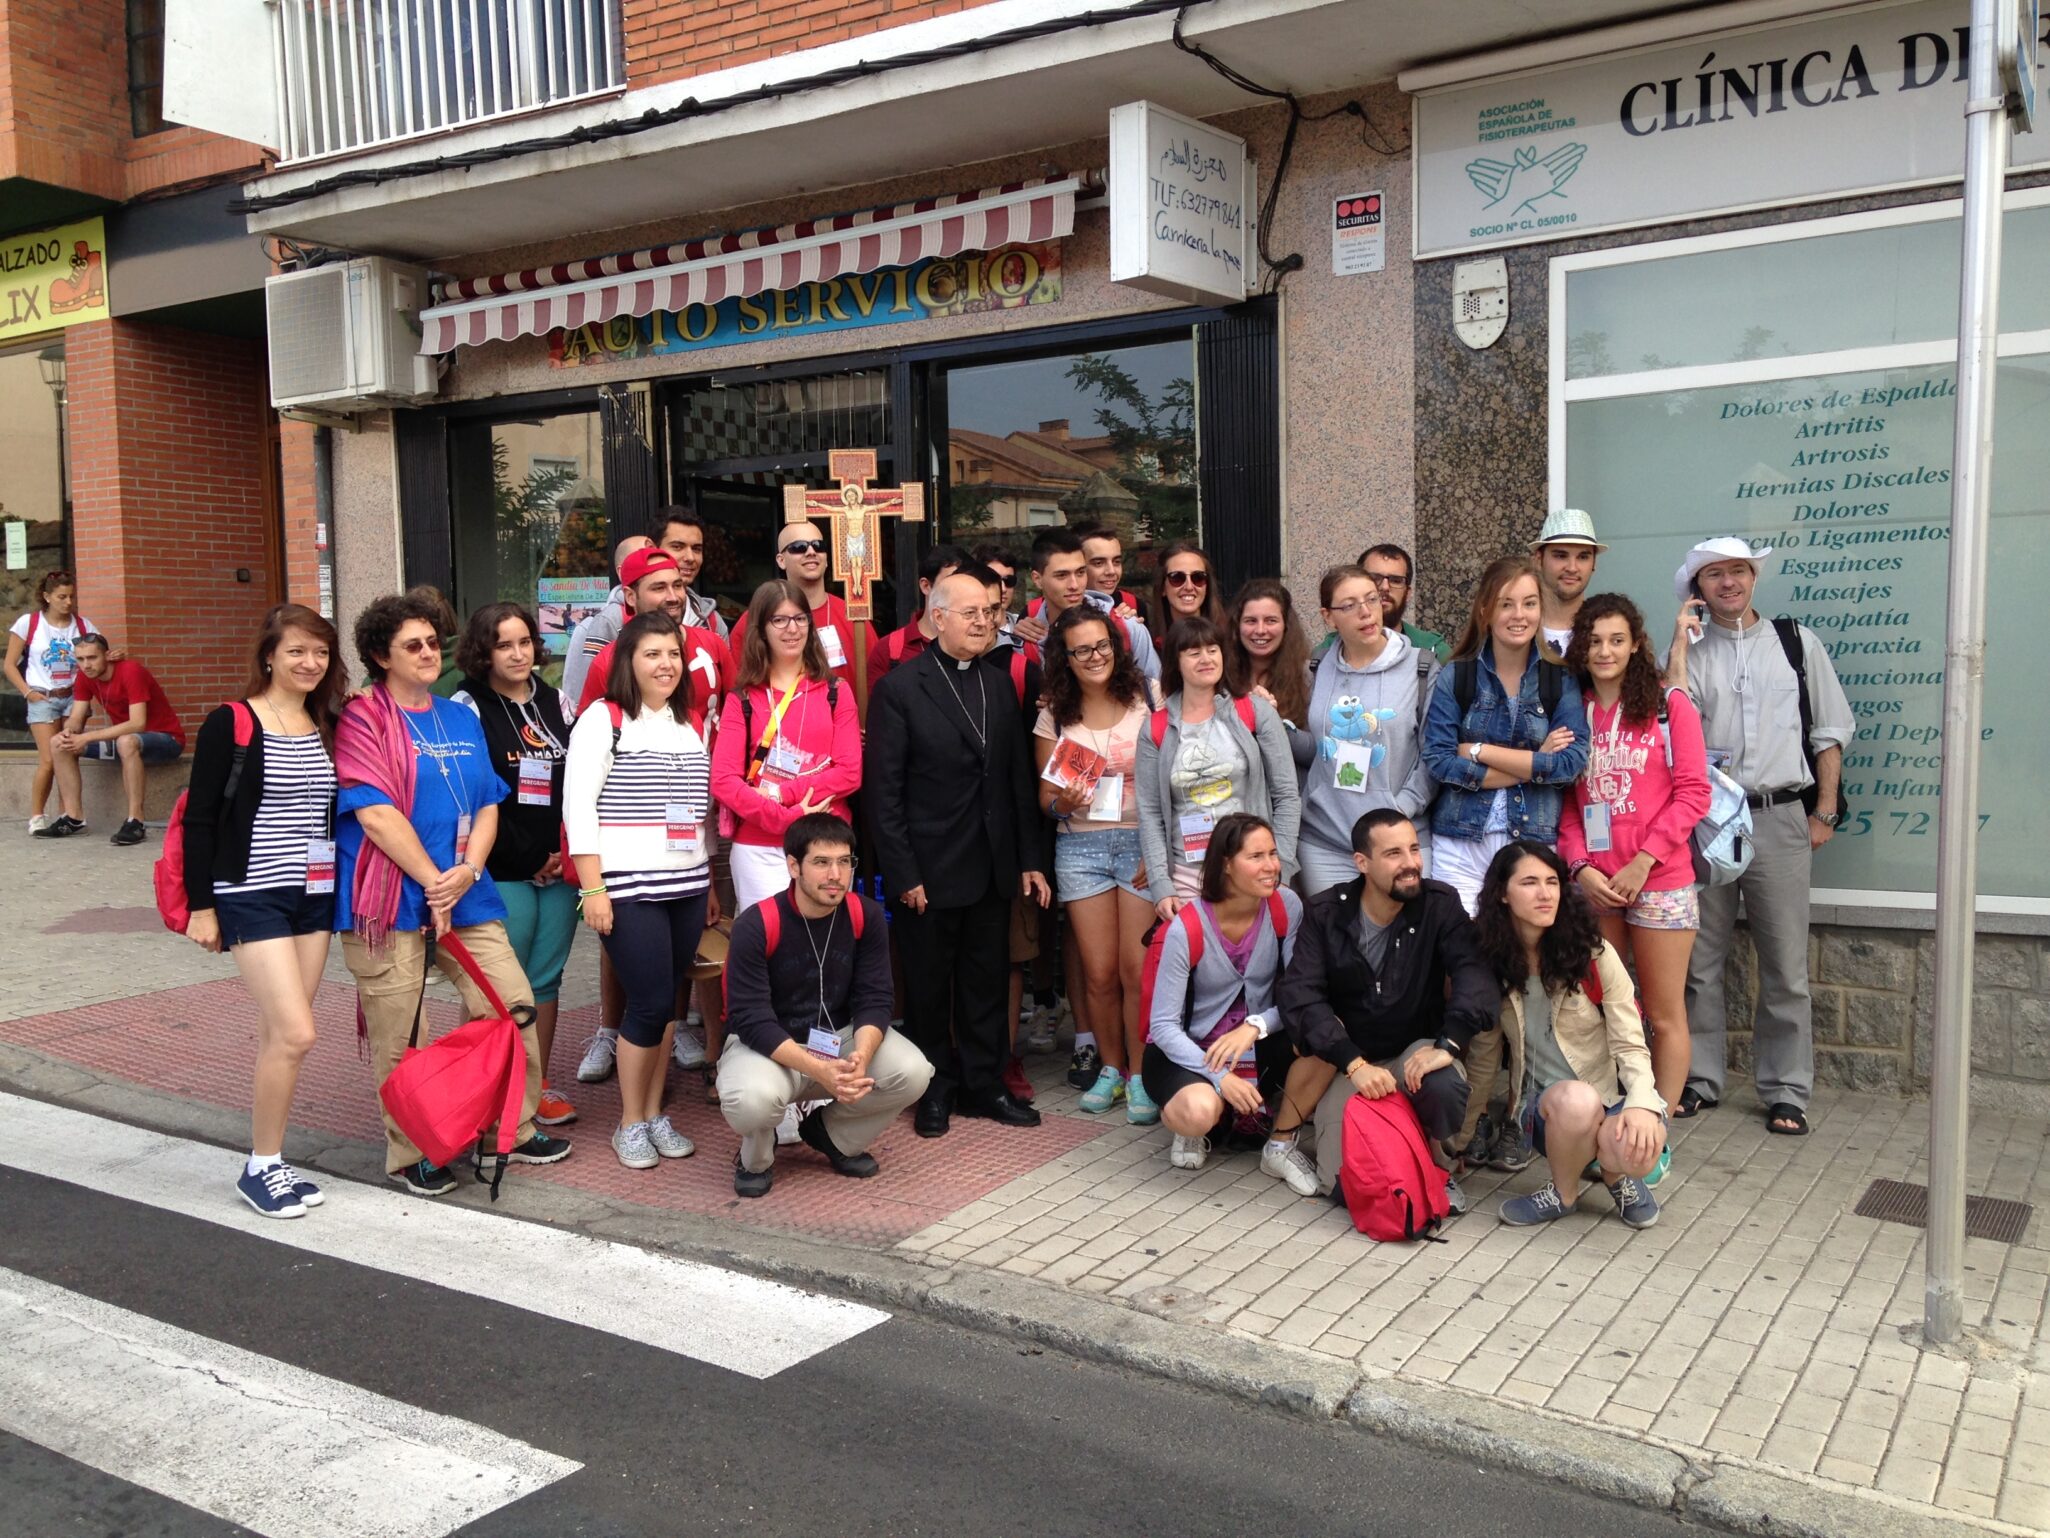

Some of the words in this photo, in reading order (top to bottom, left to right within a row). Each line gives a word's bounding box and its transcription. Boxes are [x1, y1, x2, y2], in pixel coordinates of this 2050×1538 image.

[1620, 44, 1879, 137] CLÍNICA
[1478, 98, 1545, 119] ASOCIACIÓN
[1478, 113, 1536, 131] ESPAÑOLA
[1538, 109, 1553, 119] DE
[1478, 117, 1576, 142] FISIOTERAPEUTAS
[1338, 213, 1380, 227] SECURITAS
[1470, 224, 1504, 238] SOCIO
[1520, 220, 1534, 230] CL
[1537, 213, 1577, 227] 05/0010
[739, 250, 1041, 335] SERVICIO
[1720, 396, 1815, 420] Dolores
[1821, 390, 1852, 409] de
[1794, 415, 1886, 439] Artritis
[1791, 443, 1890, 467] Artrosis
[1735, 477, 1835, 499] Hernias
[1842, 466, 1950, 490] Discales
[1792, 501, 1890, 522] Dolores
[1779, 554, 1903, 578] Esguinces
[1788, 584, 1893, 605] Masajes
[1823, 637, 1921, 660] opraxia
[1873, 778, 1941, 800] Infan
[1889, 811, 1931, 836] 72
